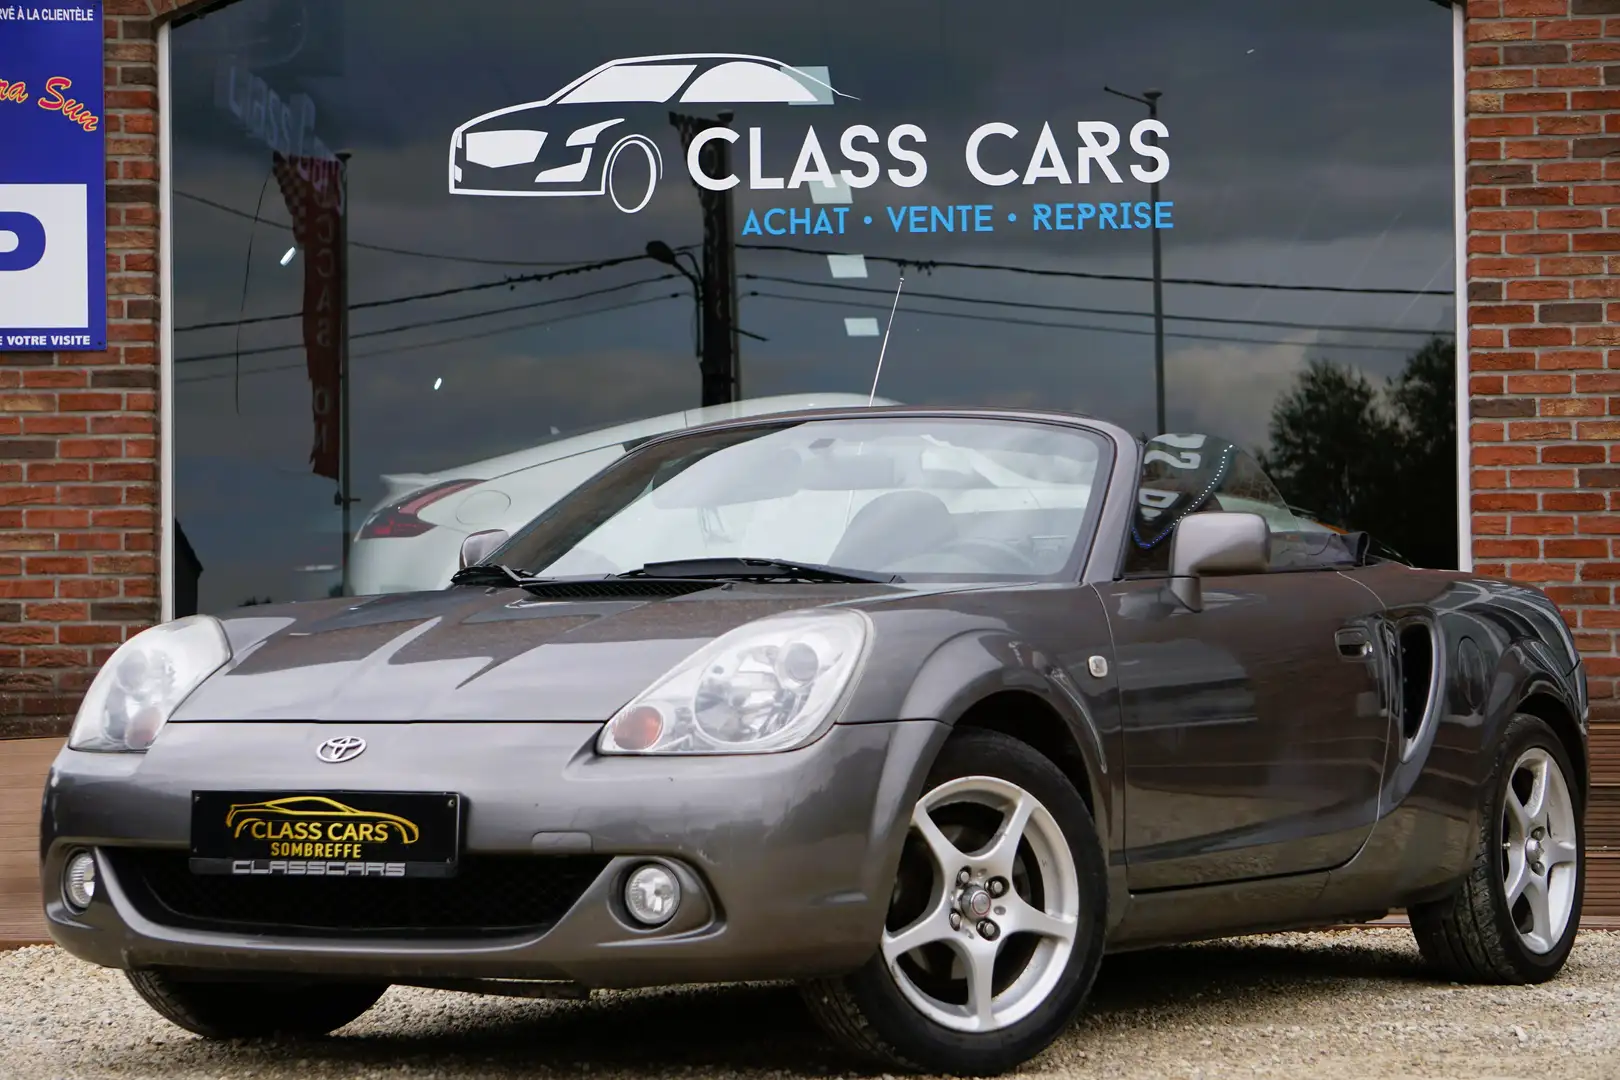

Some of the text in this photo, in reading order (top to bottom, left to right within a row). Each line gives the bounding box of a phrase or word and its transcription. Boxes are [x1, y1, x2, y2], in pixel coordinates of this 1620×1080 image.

[17, 5, 25, 20] À
[27, 8, 40, 20] LA
[41, 6, 94, 21] CLIENTÈLE
[37, 76, 99, 132] Sun
[687, 118, 1171, 191] CLASS CARS
[741, 201, 1175, 236] ACHAT VENTE REPRISE
[6, 335, 47, 346] VOTRE
[50, 335, 91, 346] VISITE
[251, 821, 389, 842] CLASS CARS
[270, 842, 362, 859] SOMBREFFE
[232, 860, 407, 877] CLASSCARS
